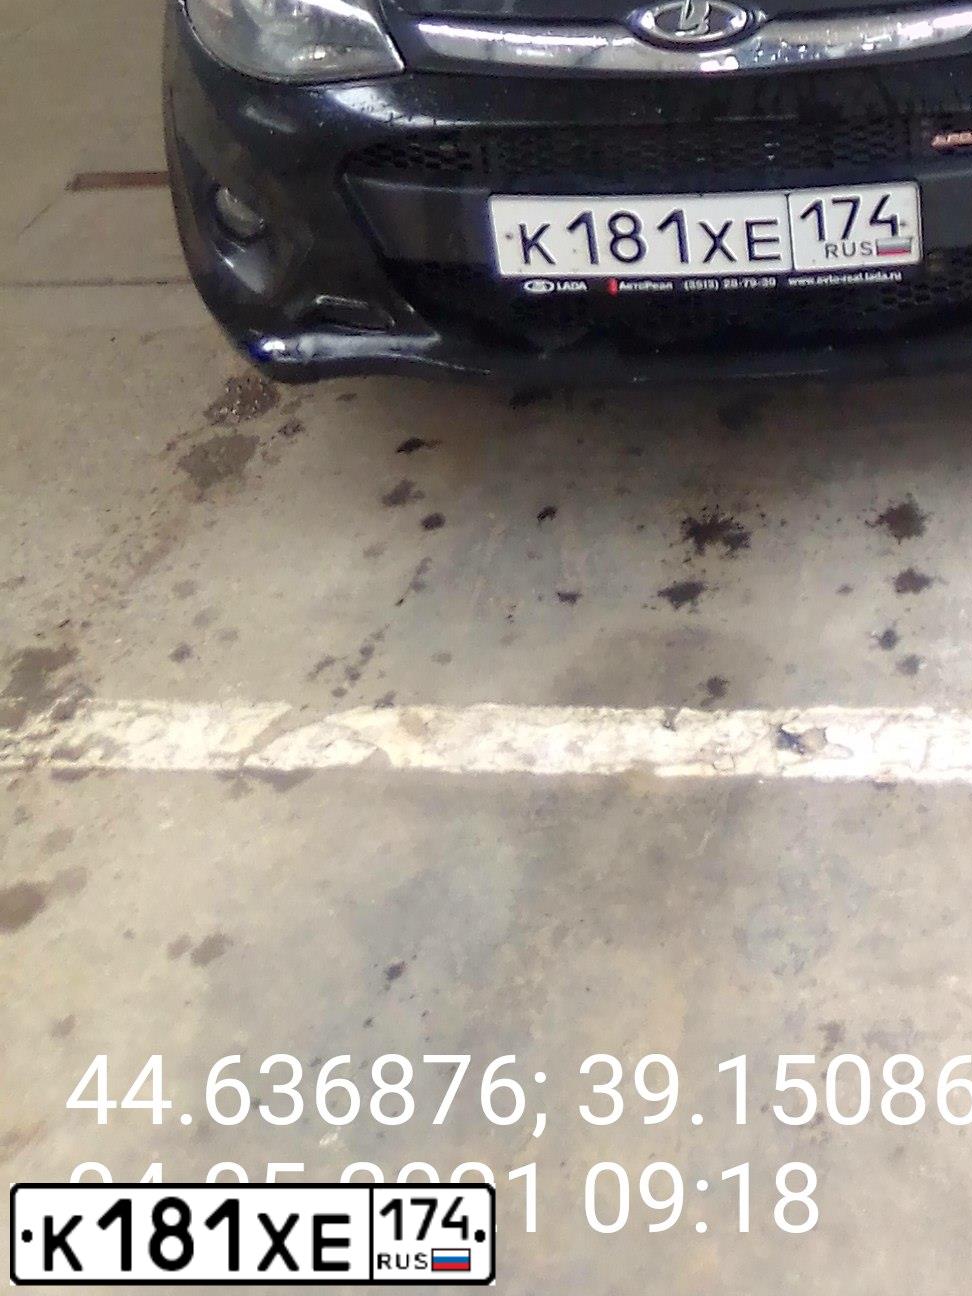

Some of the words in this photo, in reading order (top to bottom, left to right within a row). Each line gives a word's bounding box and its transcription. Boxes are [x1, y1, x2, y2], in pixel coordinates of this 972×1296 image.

[799, 193, 899, 242] 174
[824, 240, 873, 259] RUS
[556, 280, 588, 292] LADA
